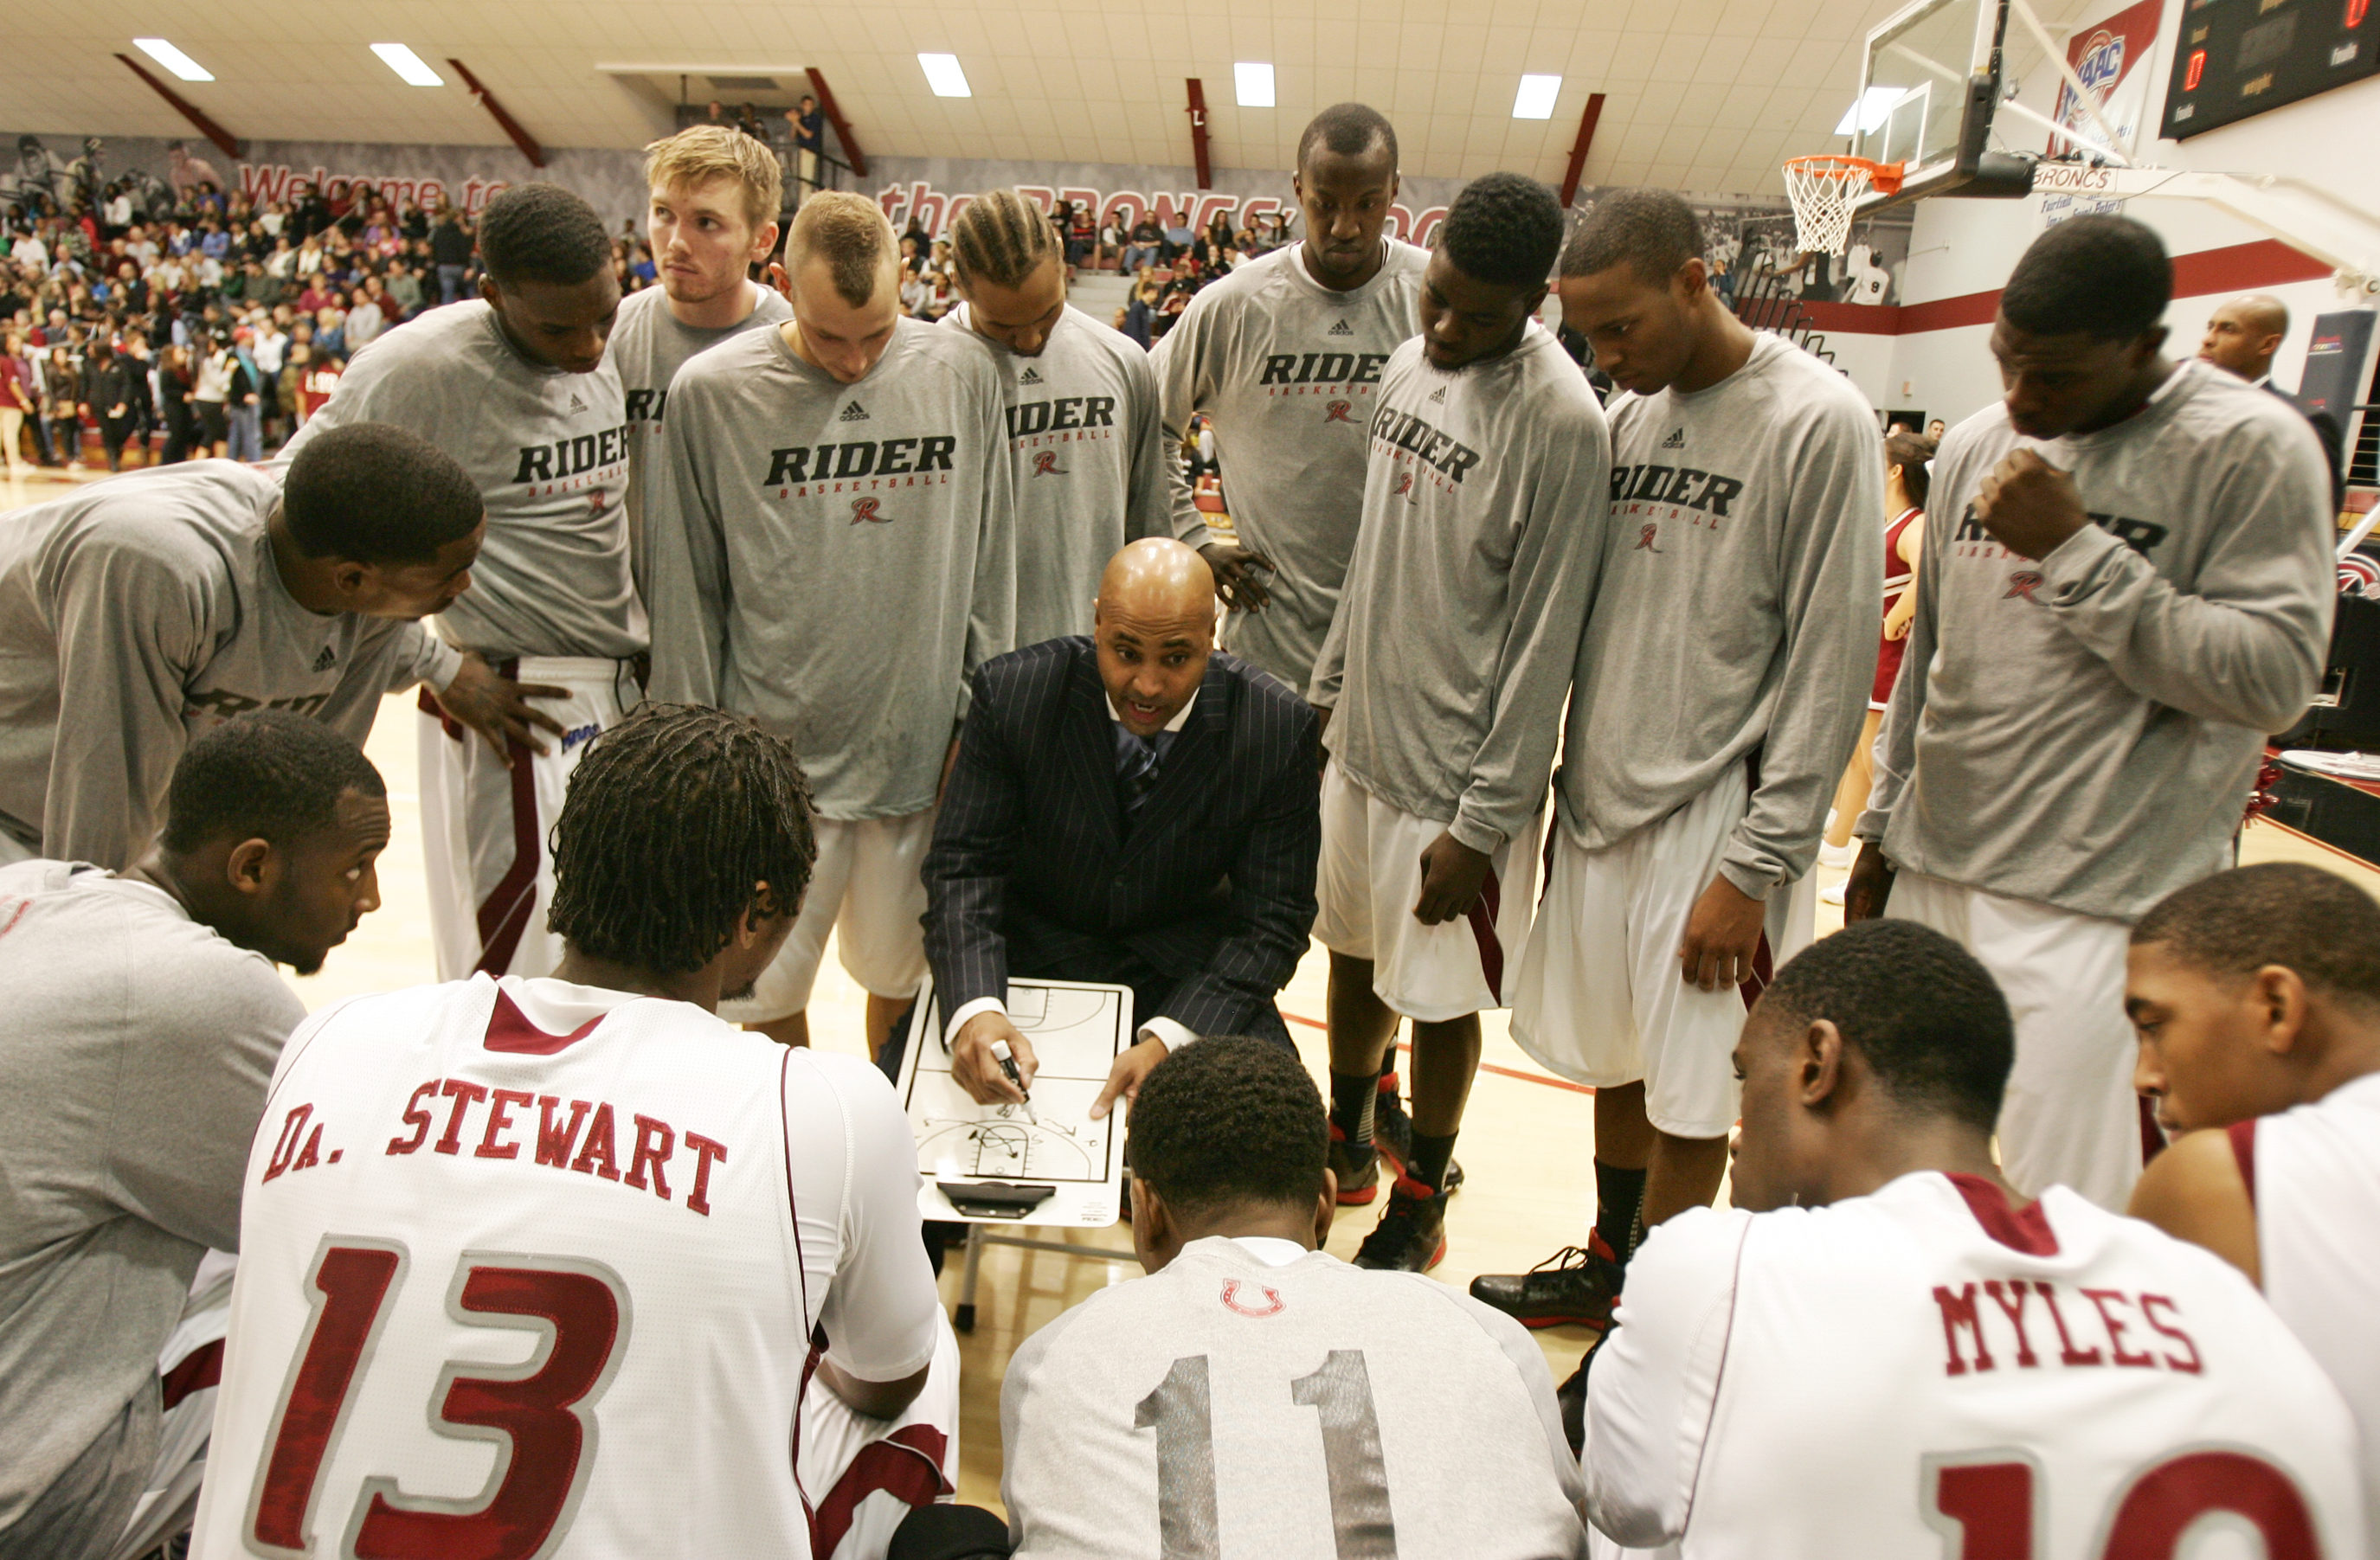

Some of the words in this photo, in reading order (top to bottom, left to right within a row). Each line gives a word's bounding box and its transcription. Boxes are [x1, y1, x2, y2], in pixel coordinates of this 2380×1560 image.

[2184, 48, 2207, 91] 0
[239, 163, 446, 220] Welcome
[2033, 168, 2110, 189] BRONCS
[1259, 353, 1390, 385] RIDE
[1270, 386, 1378, 396] BASKETB
[839, 412, 870, 421] adidas
[1006, 396, 1115, 440] IDER
[763, 436, 956, 486] RIDER
[1373, 407, 1480, 484] RIDER
[780, 474, 947, 499] BASKETBALL
[385, 1078, 727, 1217] STEWART
[1933, 1280, 2206, 1376] MYLES
[241, 1232, 634, 1560] 13
[1134, 1350, 1398, 1560] 11
